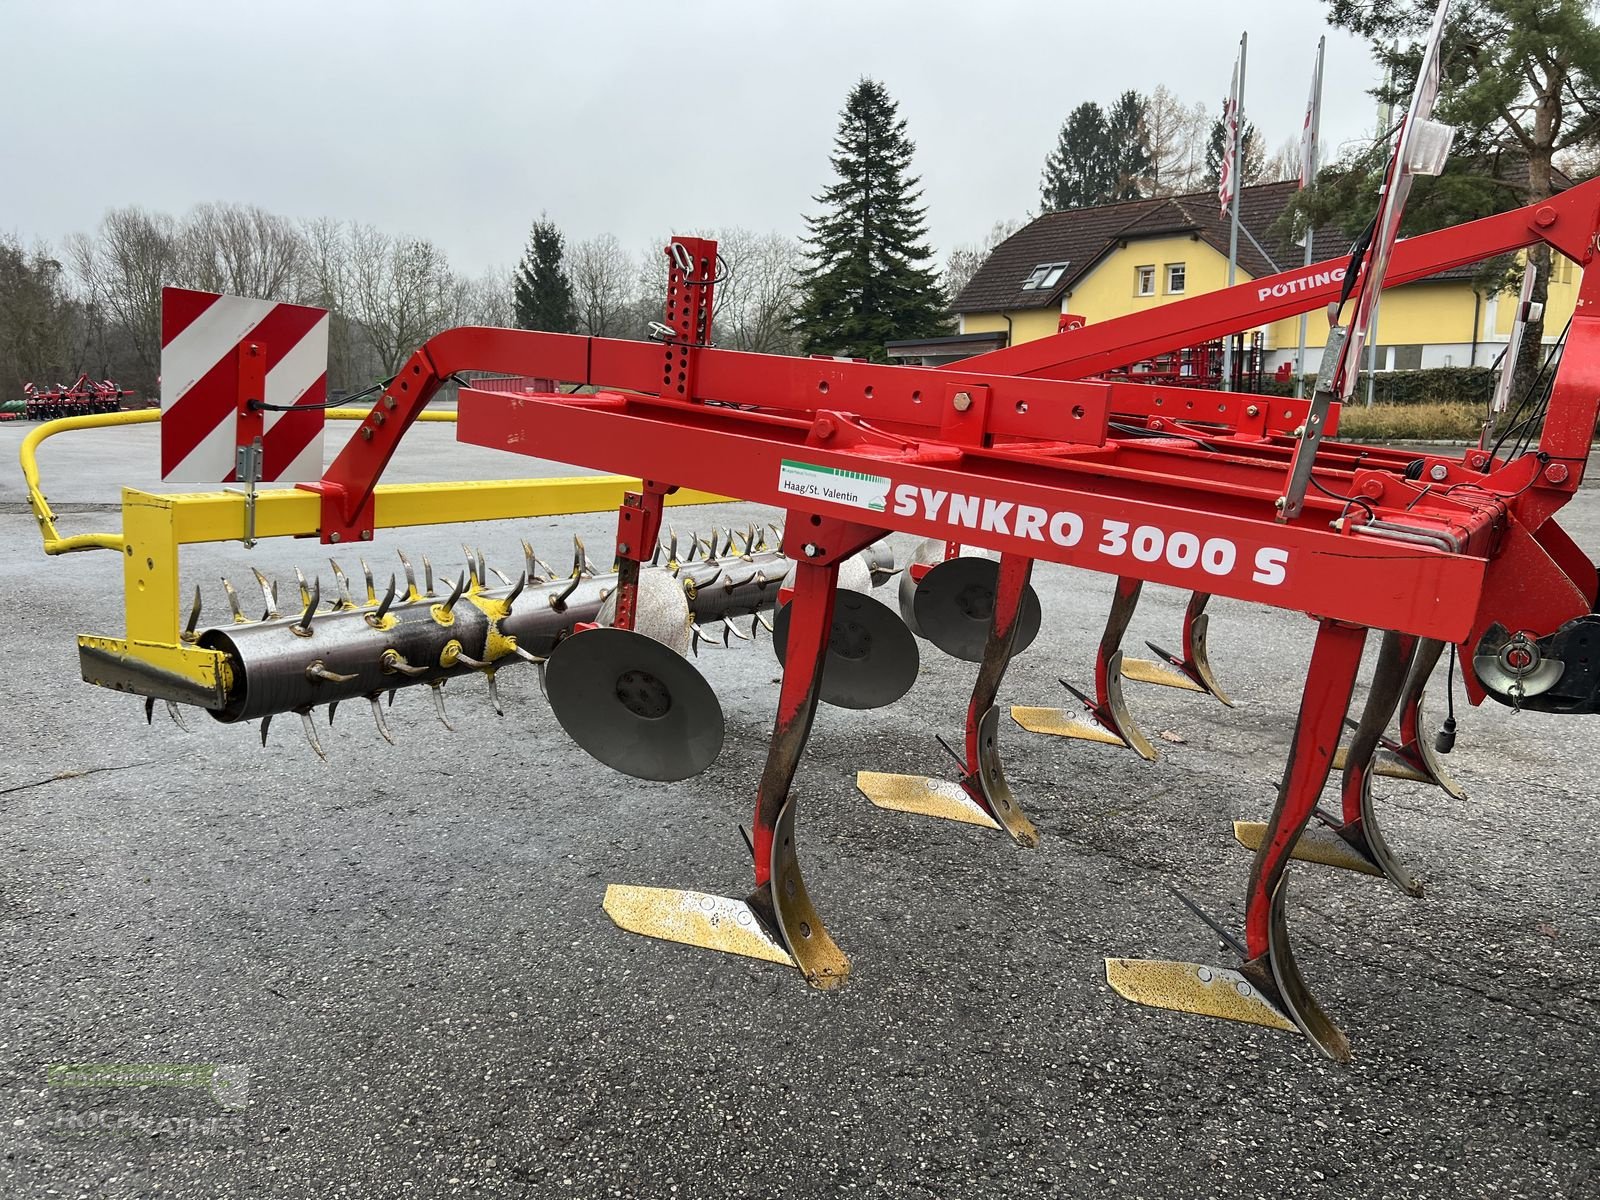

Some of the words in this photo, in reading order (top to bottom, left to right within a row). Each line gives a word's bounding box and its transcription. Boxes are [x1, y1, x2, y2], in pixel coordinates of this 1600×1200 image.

[784, 480, 820, 495] Haag/St.
[823, 487, 858, 502] Valentin
[894, 484, 1084, 547] SYNKRO
[1099, 519, 1237, 575] 3000
[1252, 547, 1289, 586] S
